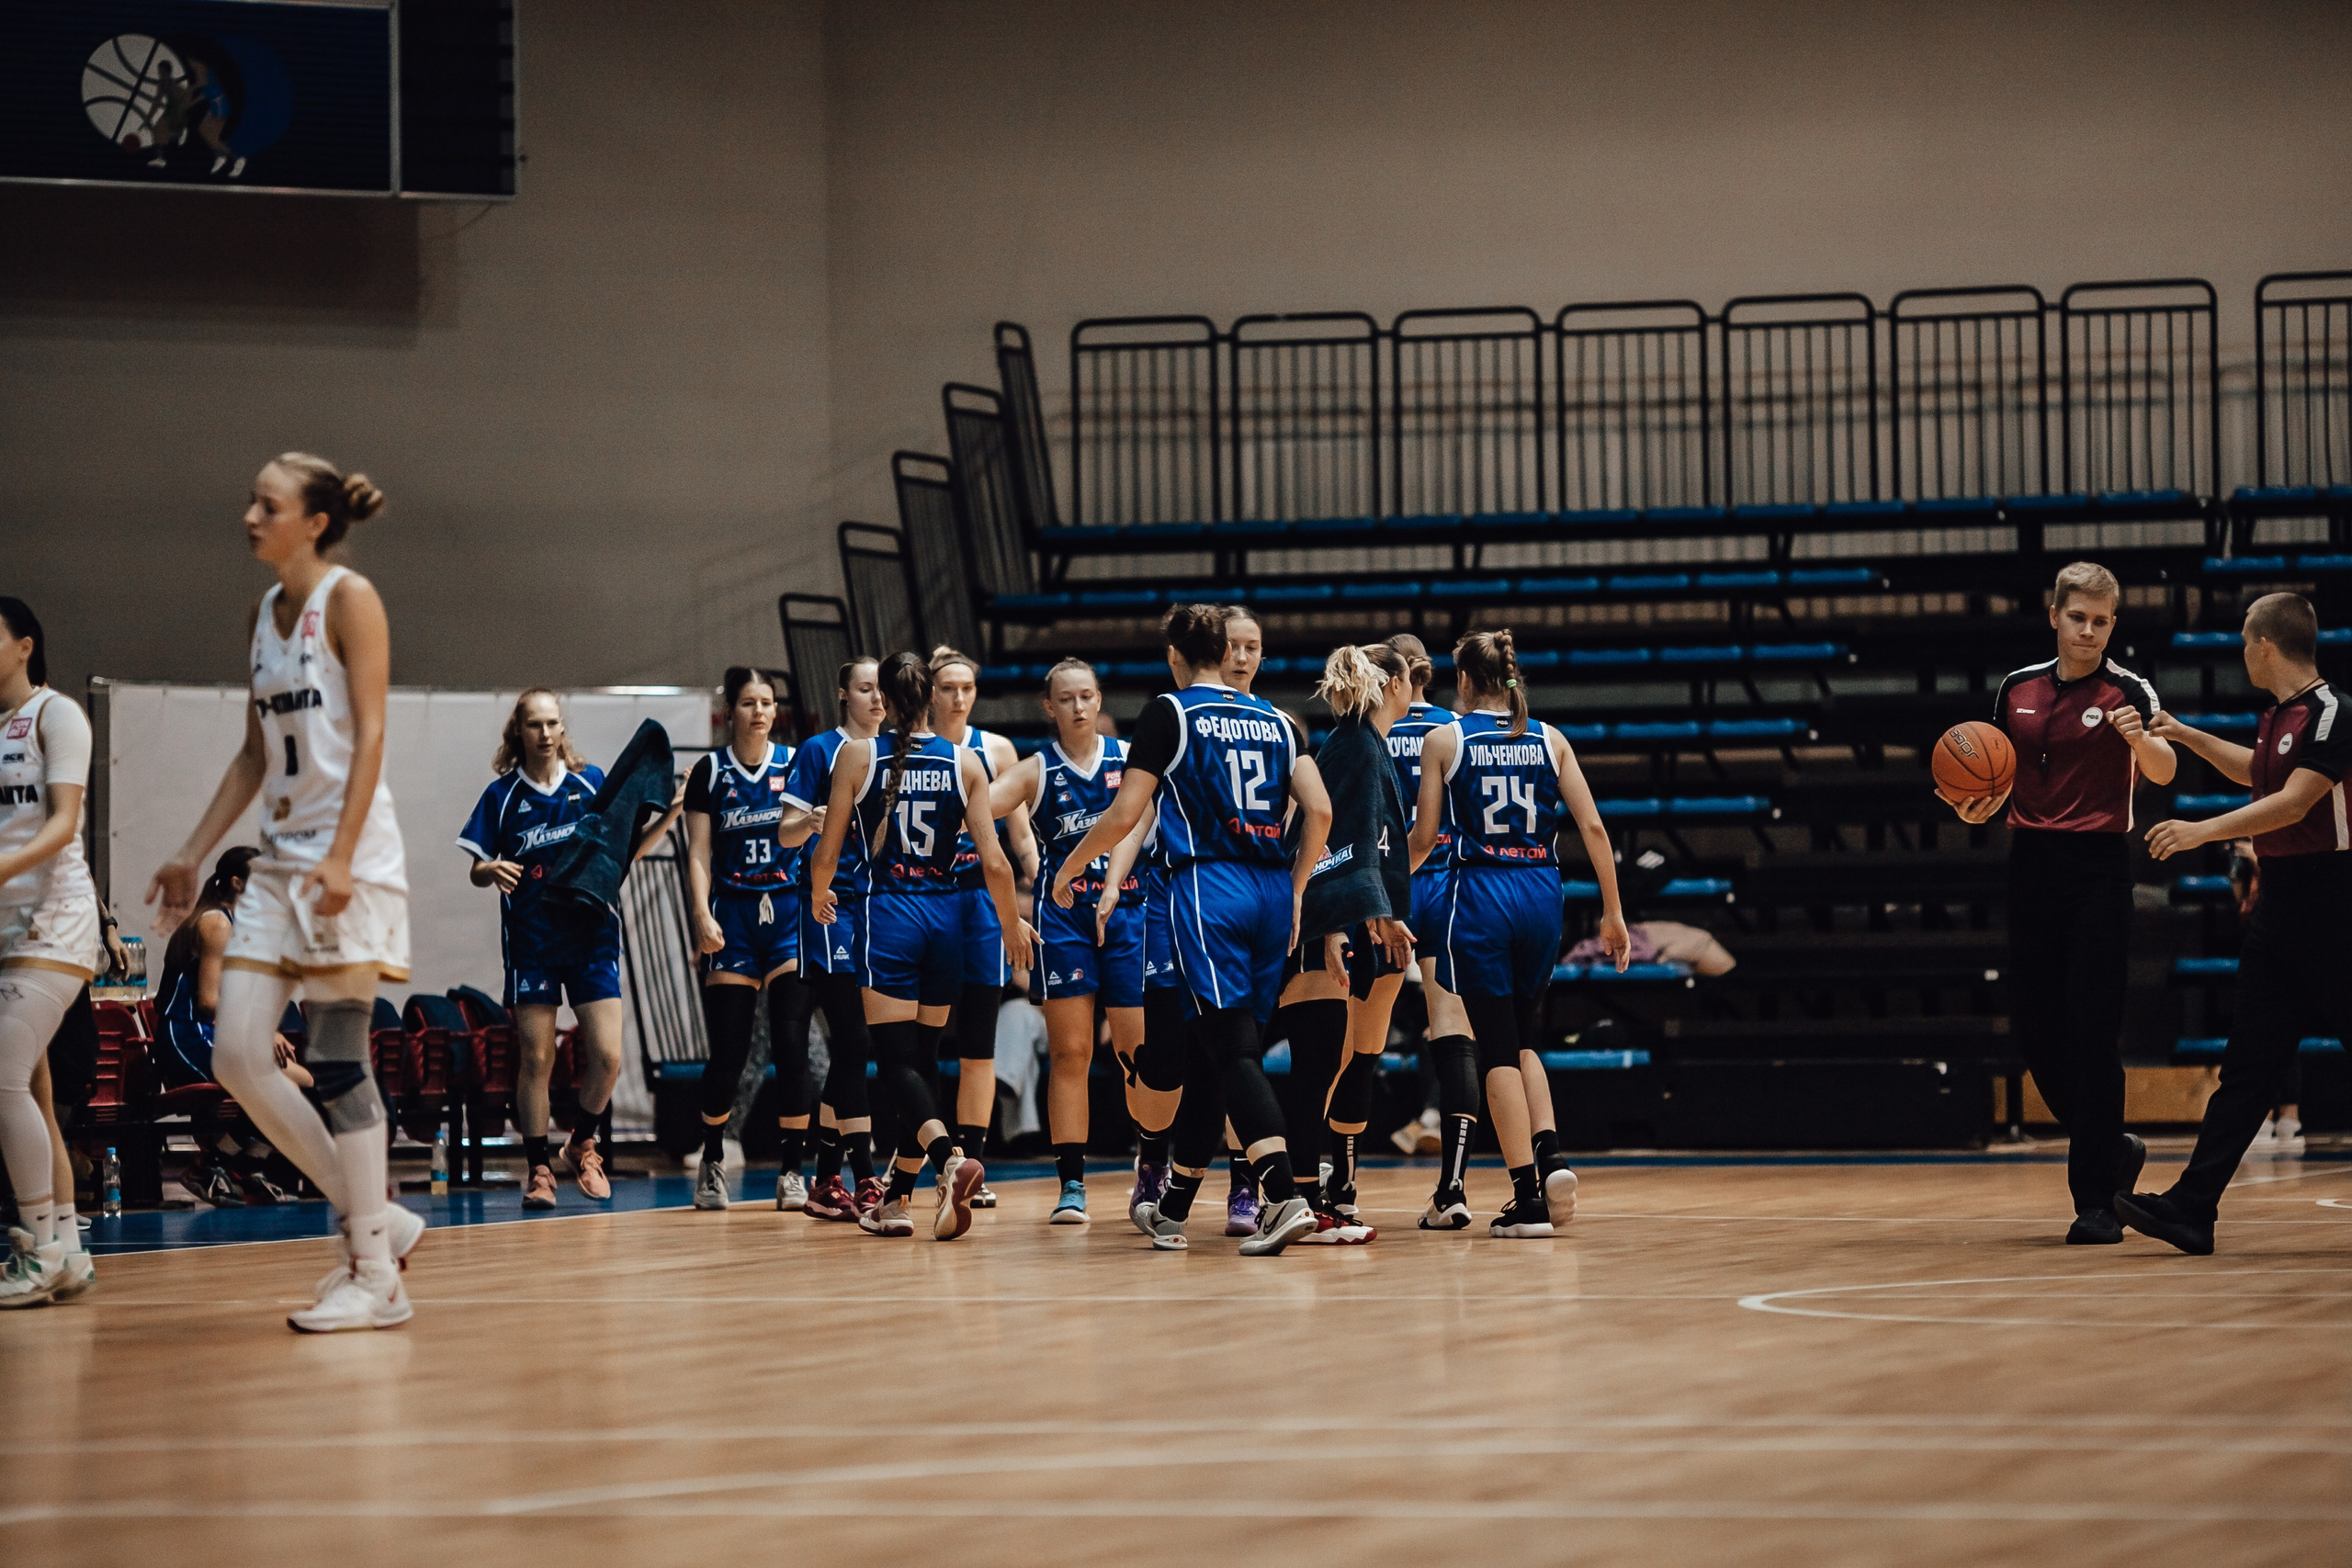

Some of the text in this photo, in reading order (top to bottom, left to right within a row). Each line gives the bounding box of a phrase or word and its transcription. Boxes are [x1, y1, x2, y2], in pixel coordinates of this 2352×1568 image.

[1196, 716, 1283, 743] ФЕДОТОВА
[285, 735, 299, 776] 1
[1469, 744, 1544, 766] УЛЬЧЕНКОВА
[1225, 750, 1271, 811] 12
[1481, 775, 1537, 835] 24
[896, 800, 936, 857] 15
[745, 839, 771, 863] 33
[1499, 844, 1547, 859] летай
